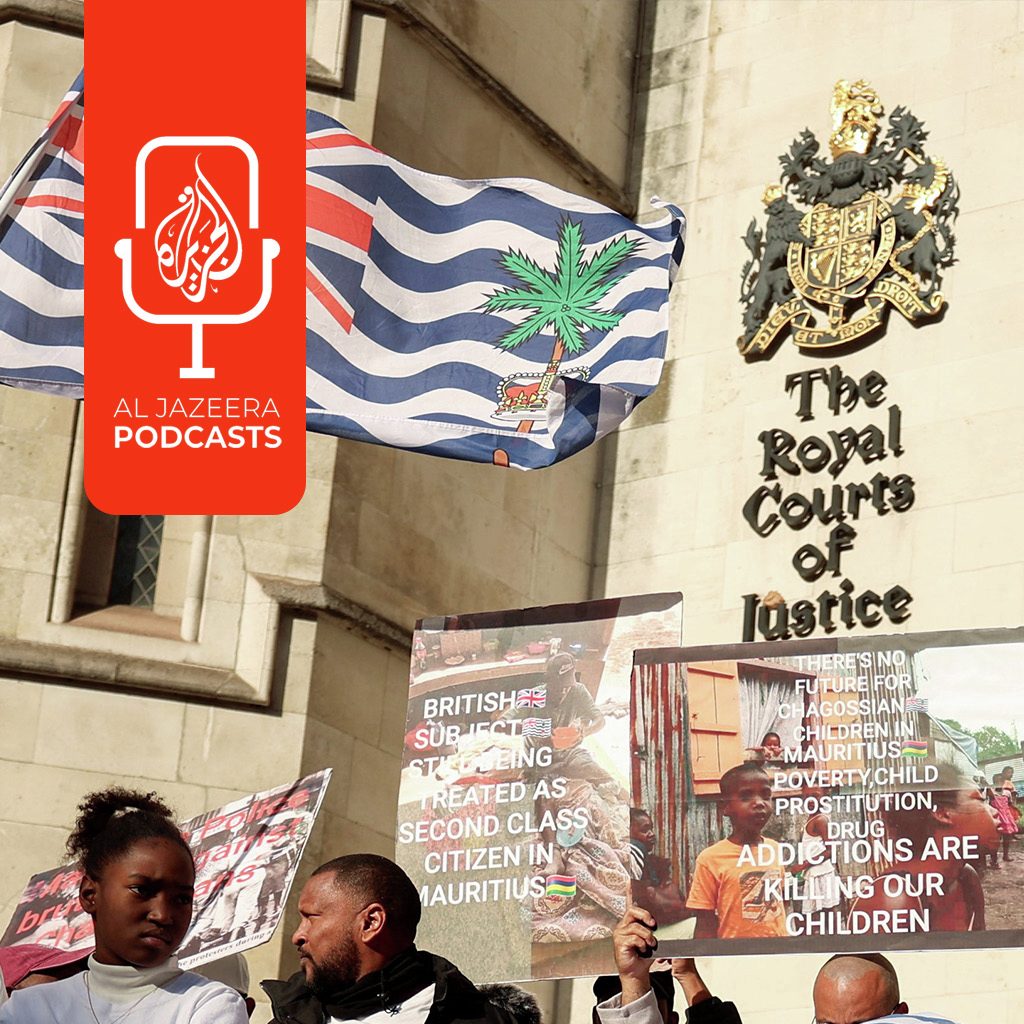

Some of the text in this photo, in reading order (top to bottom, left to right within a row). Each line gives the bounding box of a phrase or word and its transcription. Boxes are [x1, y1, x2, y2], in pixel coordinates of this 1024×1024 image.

[795, 331, 824, 343] ET
[839, 312, 880, 340] MON
[876, 280, 921, 318] DROIT
[785, 364, 888, 422] The
[758, 404, 905, 481] Royal
[743, 472, 915, 538] Courts
[792, 522, 857, 583] of
[741, 578, 913, 642] Justice
[795, 650, 906, 671] THERE'S NO
[795, 674, 912, 695] FUTURE FOR
[424, 690, 516, 718] BRITISH
[778, 698, 905, 719] CHAGOSSIAN
[793, 720, 915, 742] CHILDREN IN
[409, 754, 476, 778] STIL
[784, 741, 901, 763] MAURITIUS
[418, 778, 567, 811] TREATED AS
[775, 792, 938, 815] PROSTITUTION,
[200, 790, 310, 840] Police
[399, 807, 589, 843] SECOND CLASS
[827, 820, 885, 839] DRUG
[194, 817, 303, 872] gainst
[424, 843, 554, 874] CITIZEN IN
[736, 836, 980, 867] ADDICTIONS ARE
[419, 876, 545, 907] MAURITIUS
[764, 872, 945, 901] KILLING OUR
[785, 908, 931, 936] CHILDREN
